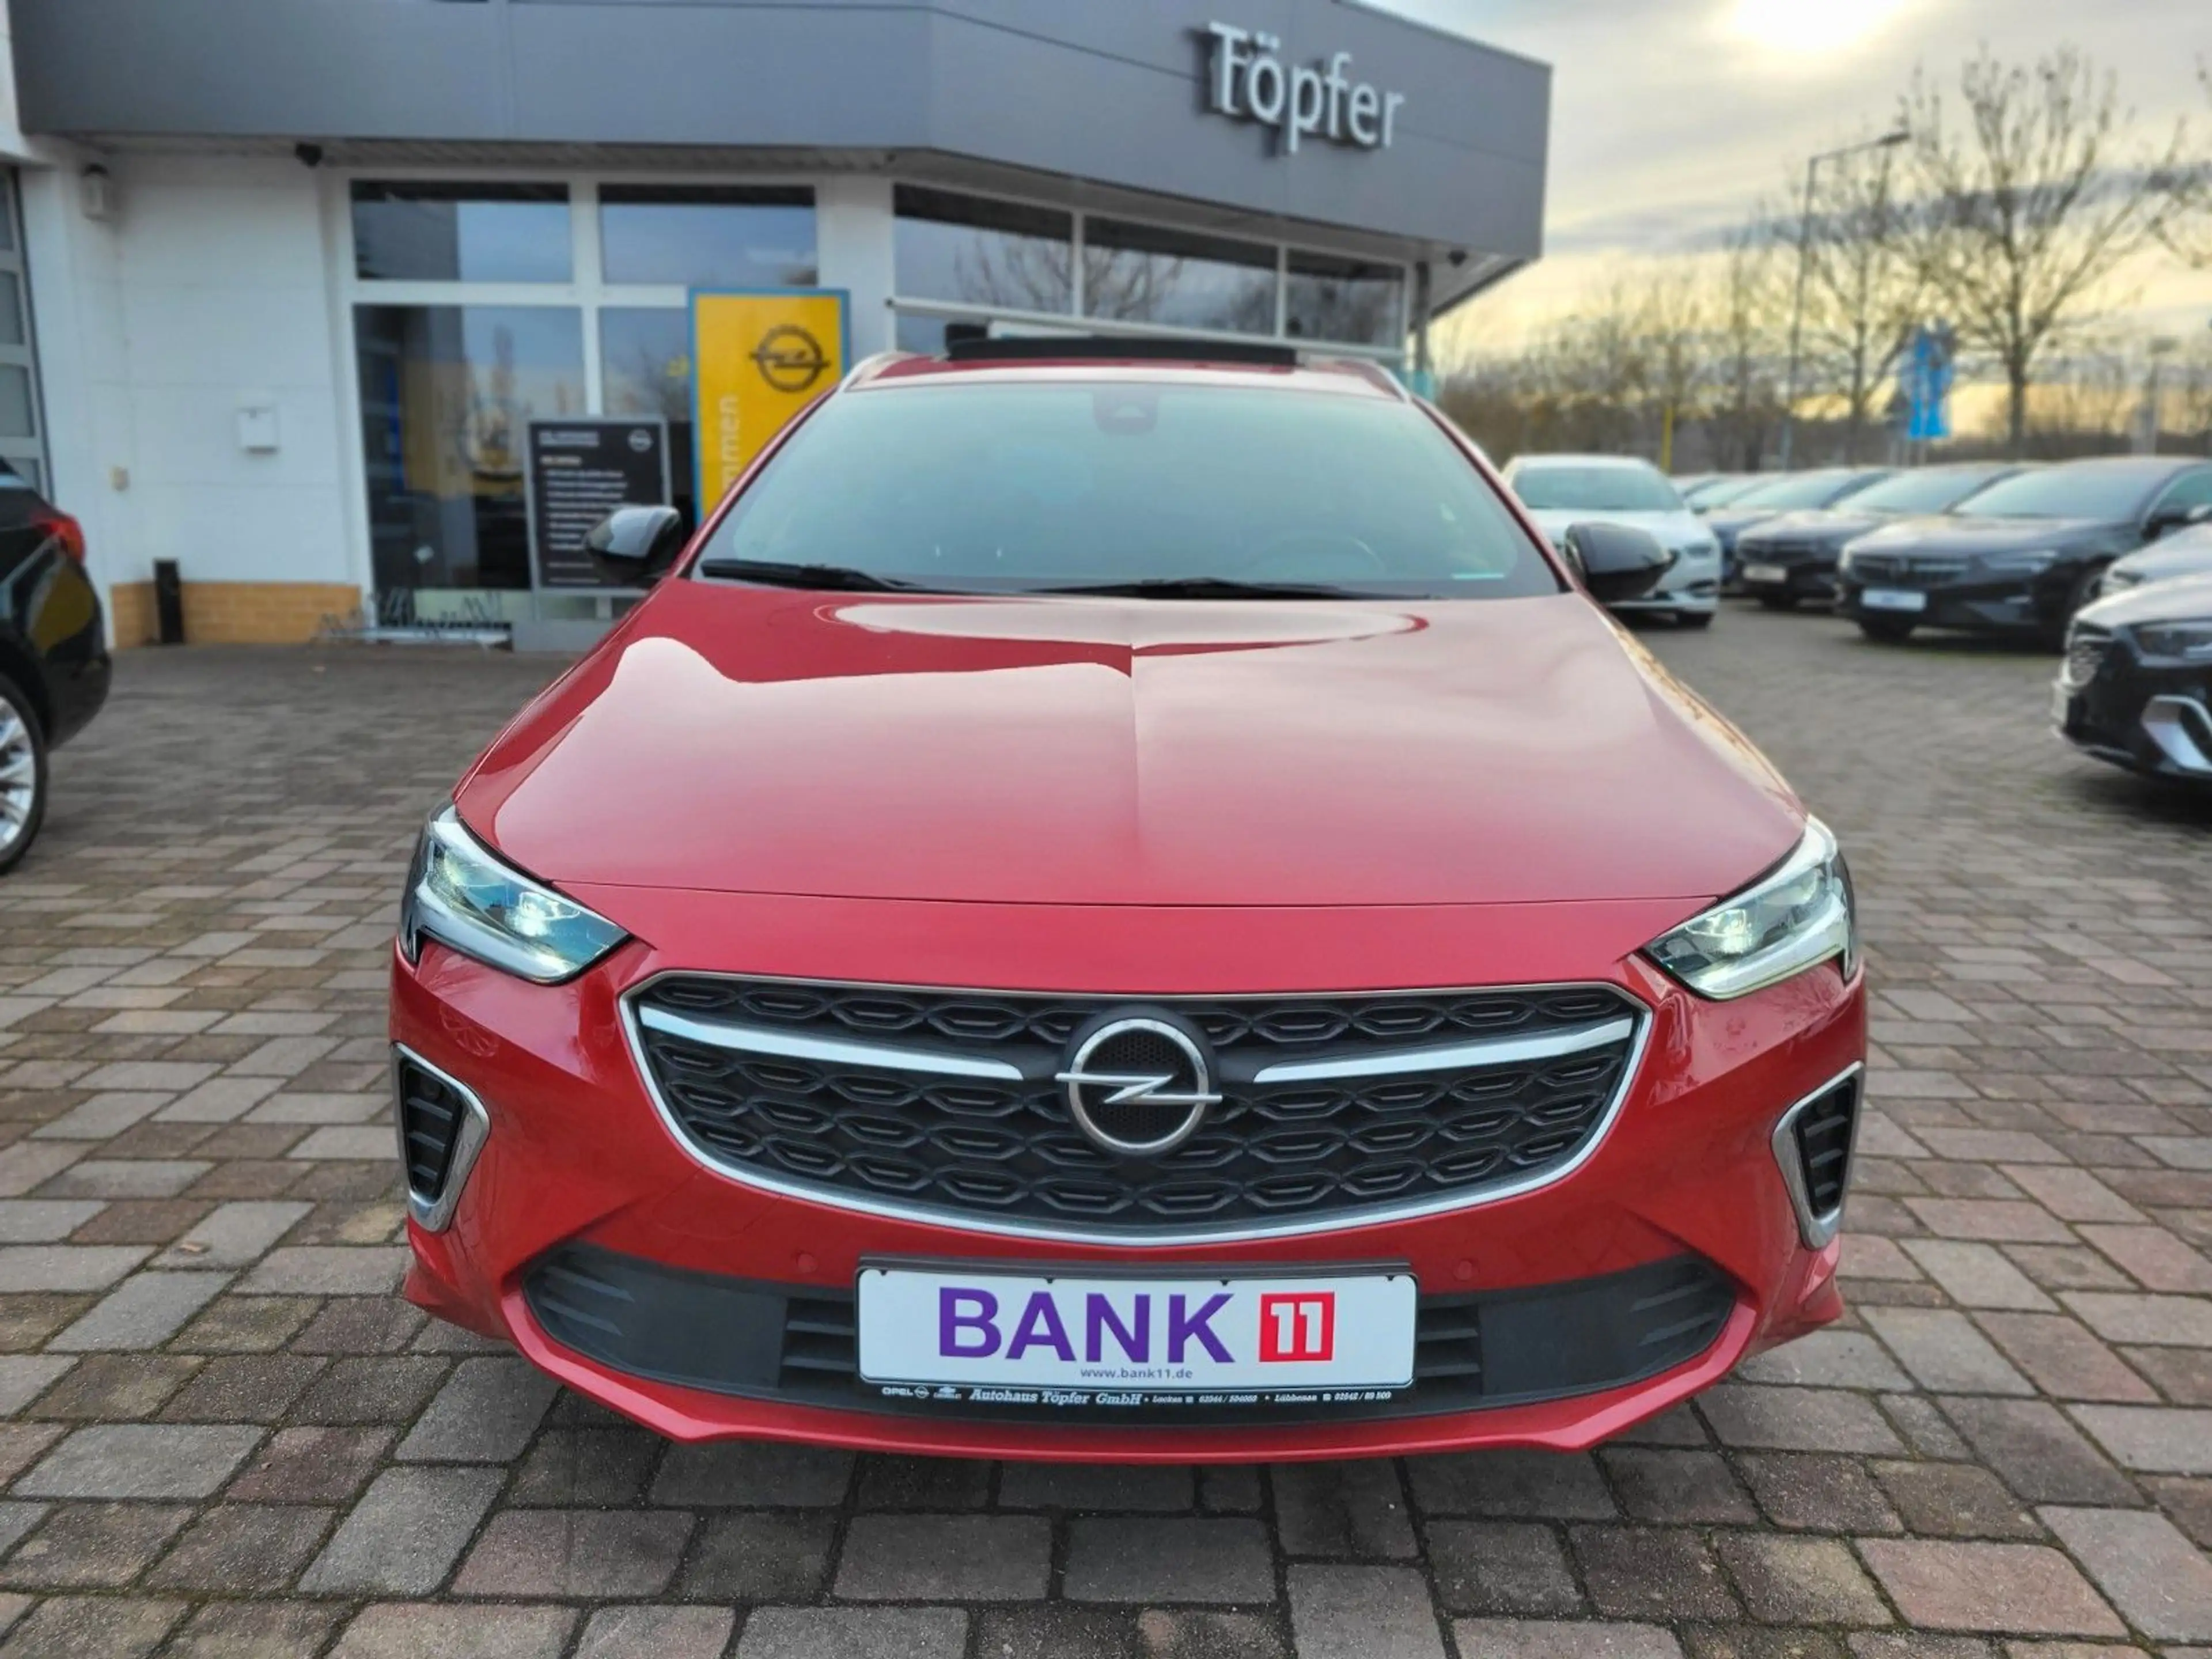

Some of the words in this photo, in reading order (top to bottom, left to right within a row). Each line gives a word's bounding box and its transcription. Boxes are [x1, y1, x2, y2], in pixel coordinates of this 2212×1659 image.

[1209, 21, 1405, 153] Töpfer
[940, 1286, 1236, 1363] BANK
[1270, 1301, 1324, 1355] 11
[1081, 1368, 1193, 1379] www.bank11.de
[881, 1386, 914, 1396] OPEL
[969, 1388, 1038, 1403] Autohaus
[1041, 1391, 1090, 1405] Töpfer
[1096, 1392, 1142, 1406] GmbH
